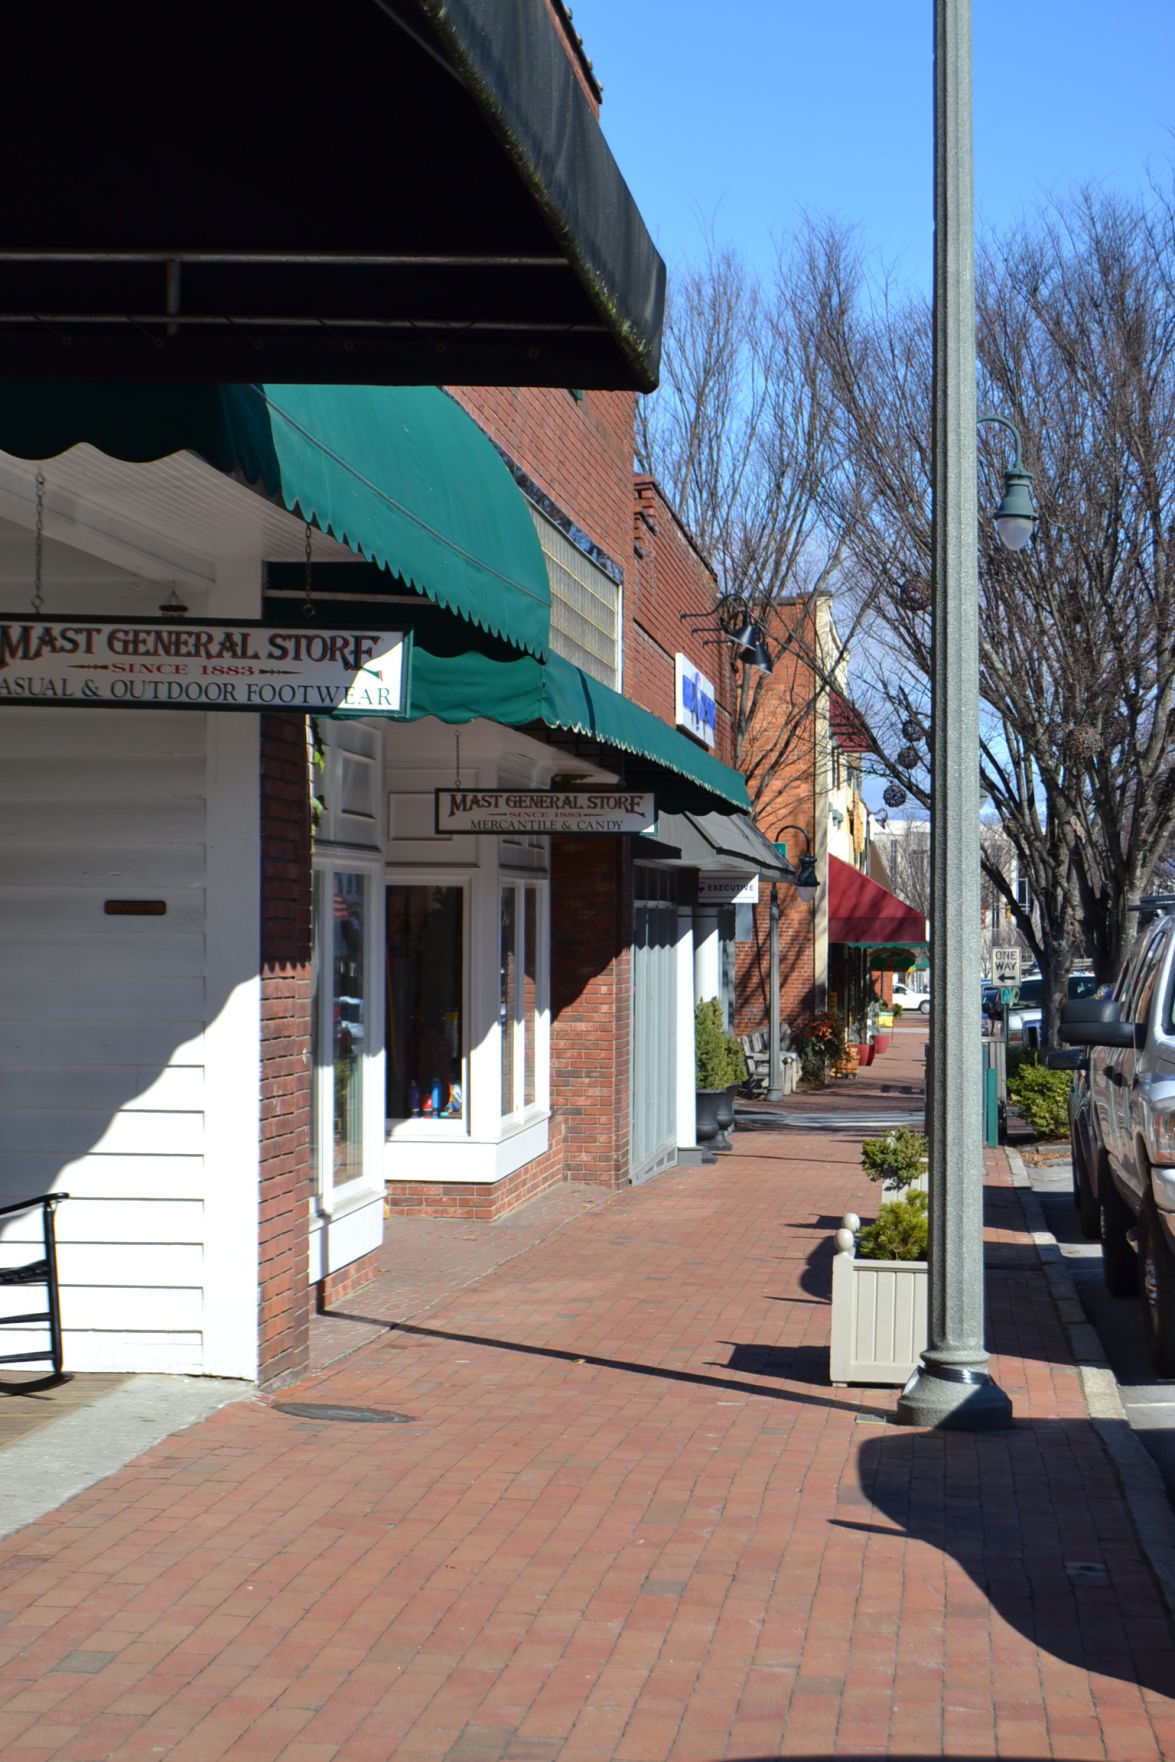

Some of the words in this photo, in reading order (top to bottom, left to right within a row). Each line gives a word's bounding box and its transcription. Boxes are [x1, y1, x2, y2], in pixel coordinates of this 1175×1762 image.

[0, 624, 102, 670] MAST
[106, 628, 261, 660] GENERAL
[266, 632, 384, 682] STORE
[111, 663, 188, 675] SINCE
[200, 665, 254, 676] 1883
[81, 678, 102, 697] &
[110, 679, 238, 702] OUTDOOR
[246, 683, 392, 706] FOOTWEAR
[448, 793, 503, 817] MAST
[505, 794, 585, 810] GENERAL
[586, 795, 647, 819] STORE
[470, 819, 557, 831] MERCANTILE
[560, 820, 572, 831] &
[576, 820, 624, 832] CANDY
[707, 884, 754, 892] EXECUTIVE
[995, 950, 1017, 960] ONE
[995, 962, 1018, 971] WAY
